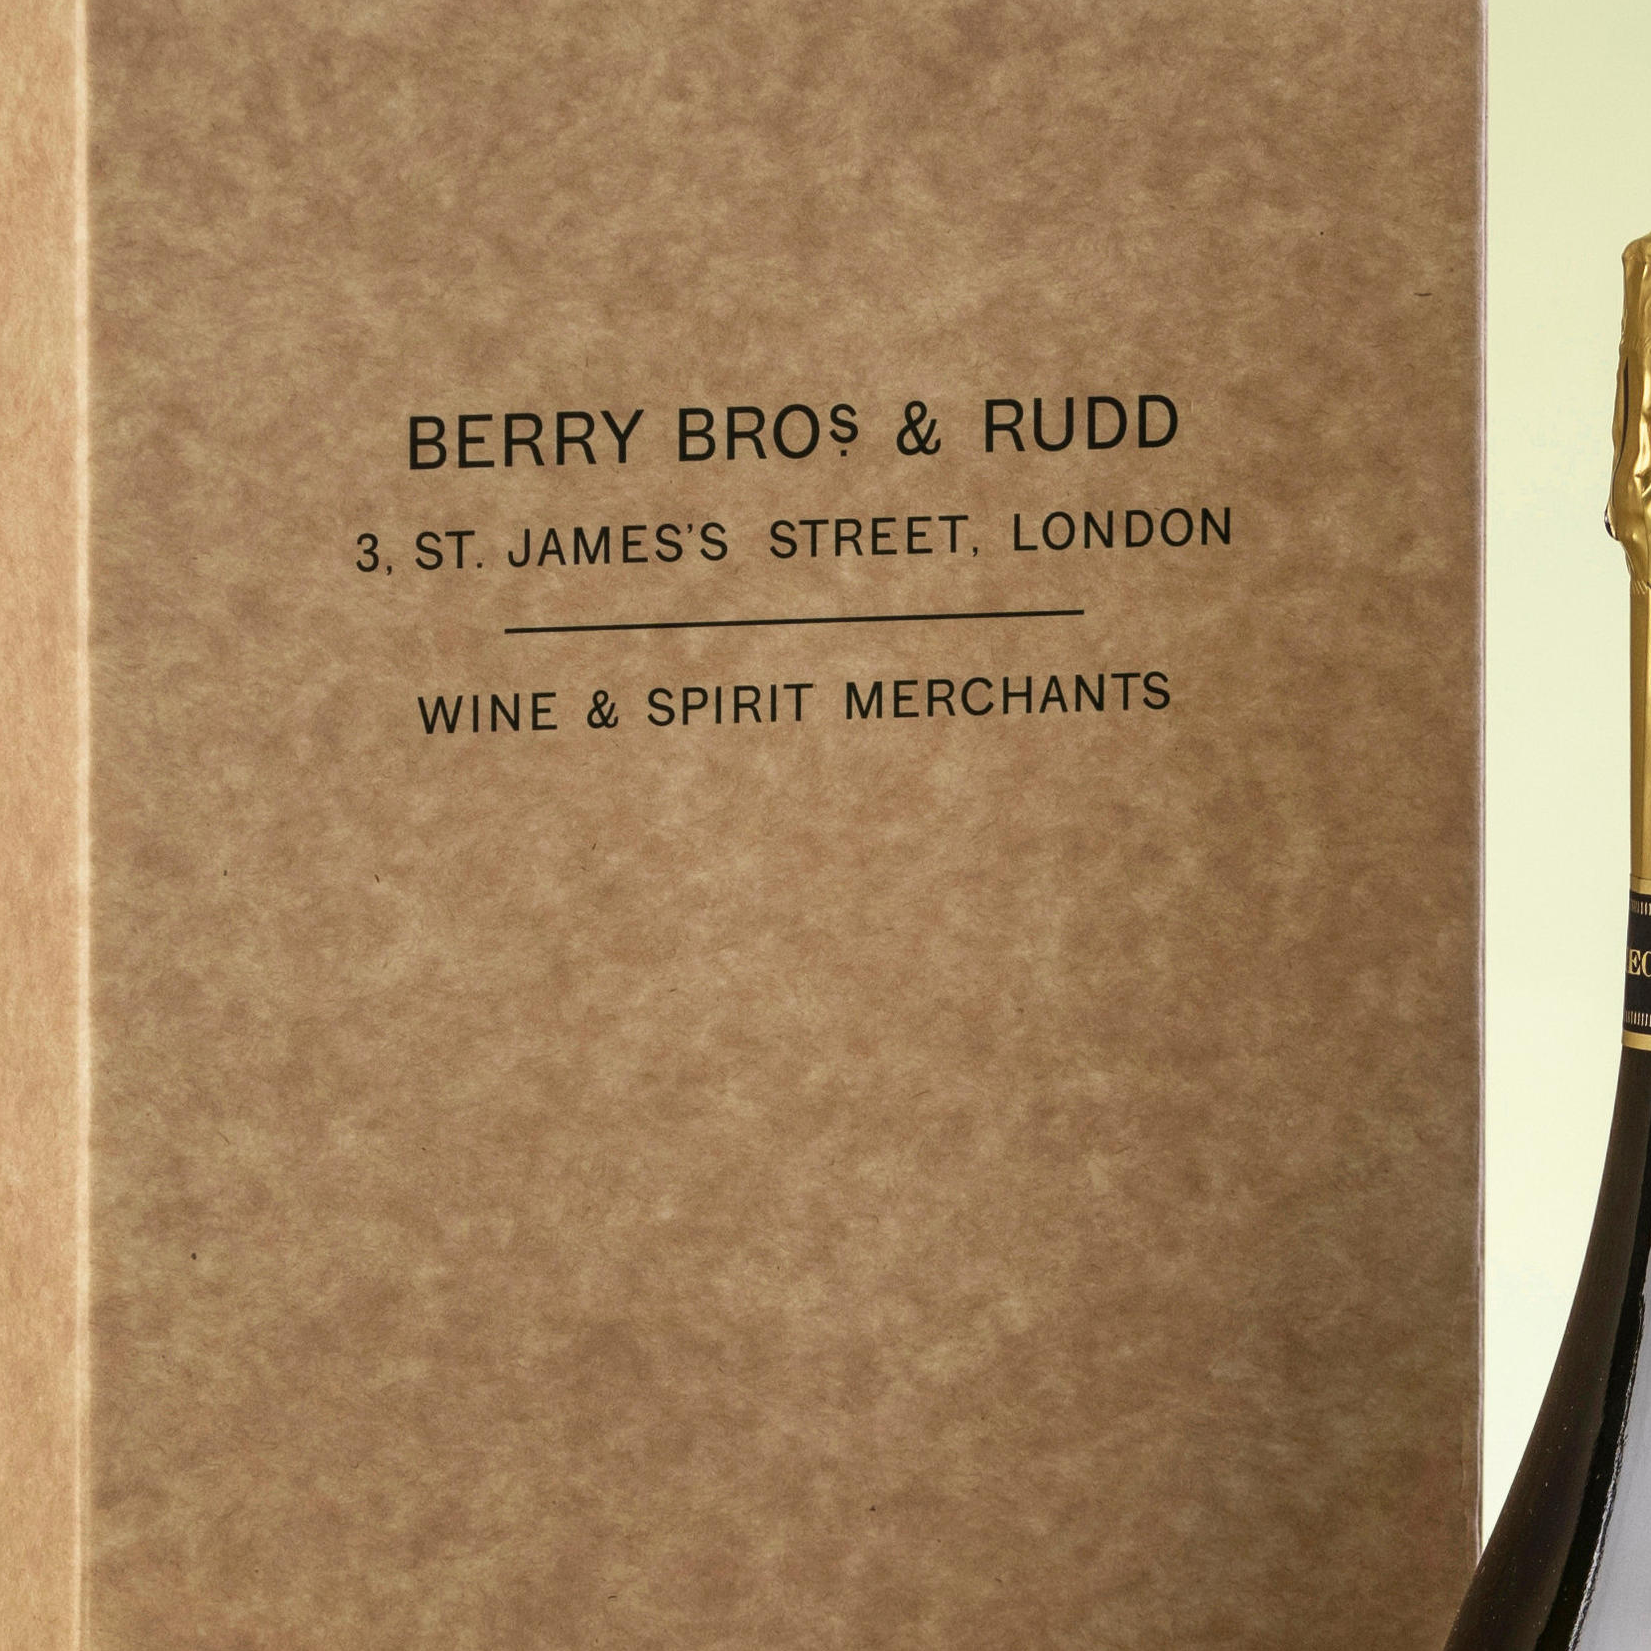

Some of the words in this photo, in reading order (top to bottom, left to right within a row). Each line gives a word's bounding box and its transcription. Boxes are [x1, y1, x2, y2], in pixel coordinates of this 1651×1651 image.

[409, 409, 645, 470] BERRY
[896, 400, 942, 456] &
[985, 394, 1179, 453] RUDD
[356, 532, 393, 576] 3,
[415, 530, 483, 571] ST.
[507, 521, 728, 568] JAMES'S
[769, 514, 979, 559] STREET,
[1013, 506, 1231, 551] LONDON
[417, 691, 558, 735] WINE
[586, 689, 619, 729] &
[647, 683, 814, 727] SPIRIT
[846, 671, 1171, 720] MERCHANTS
